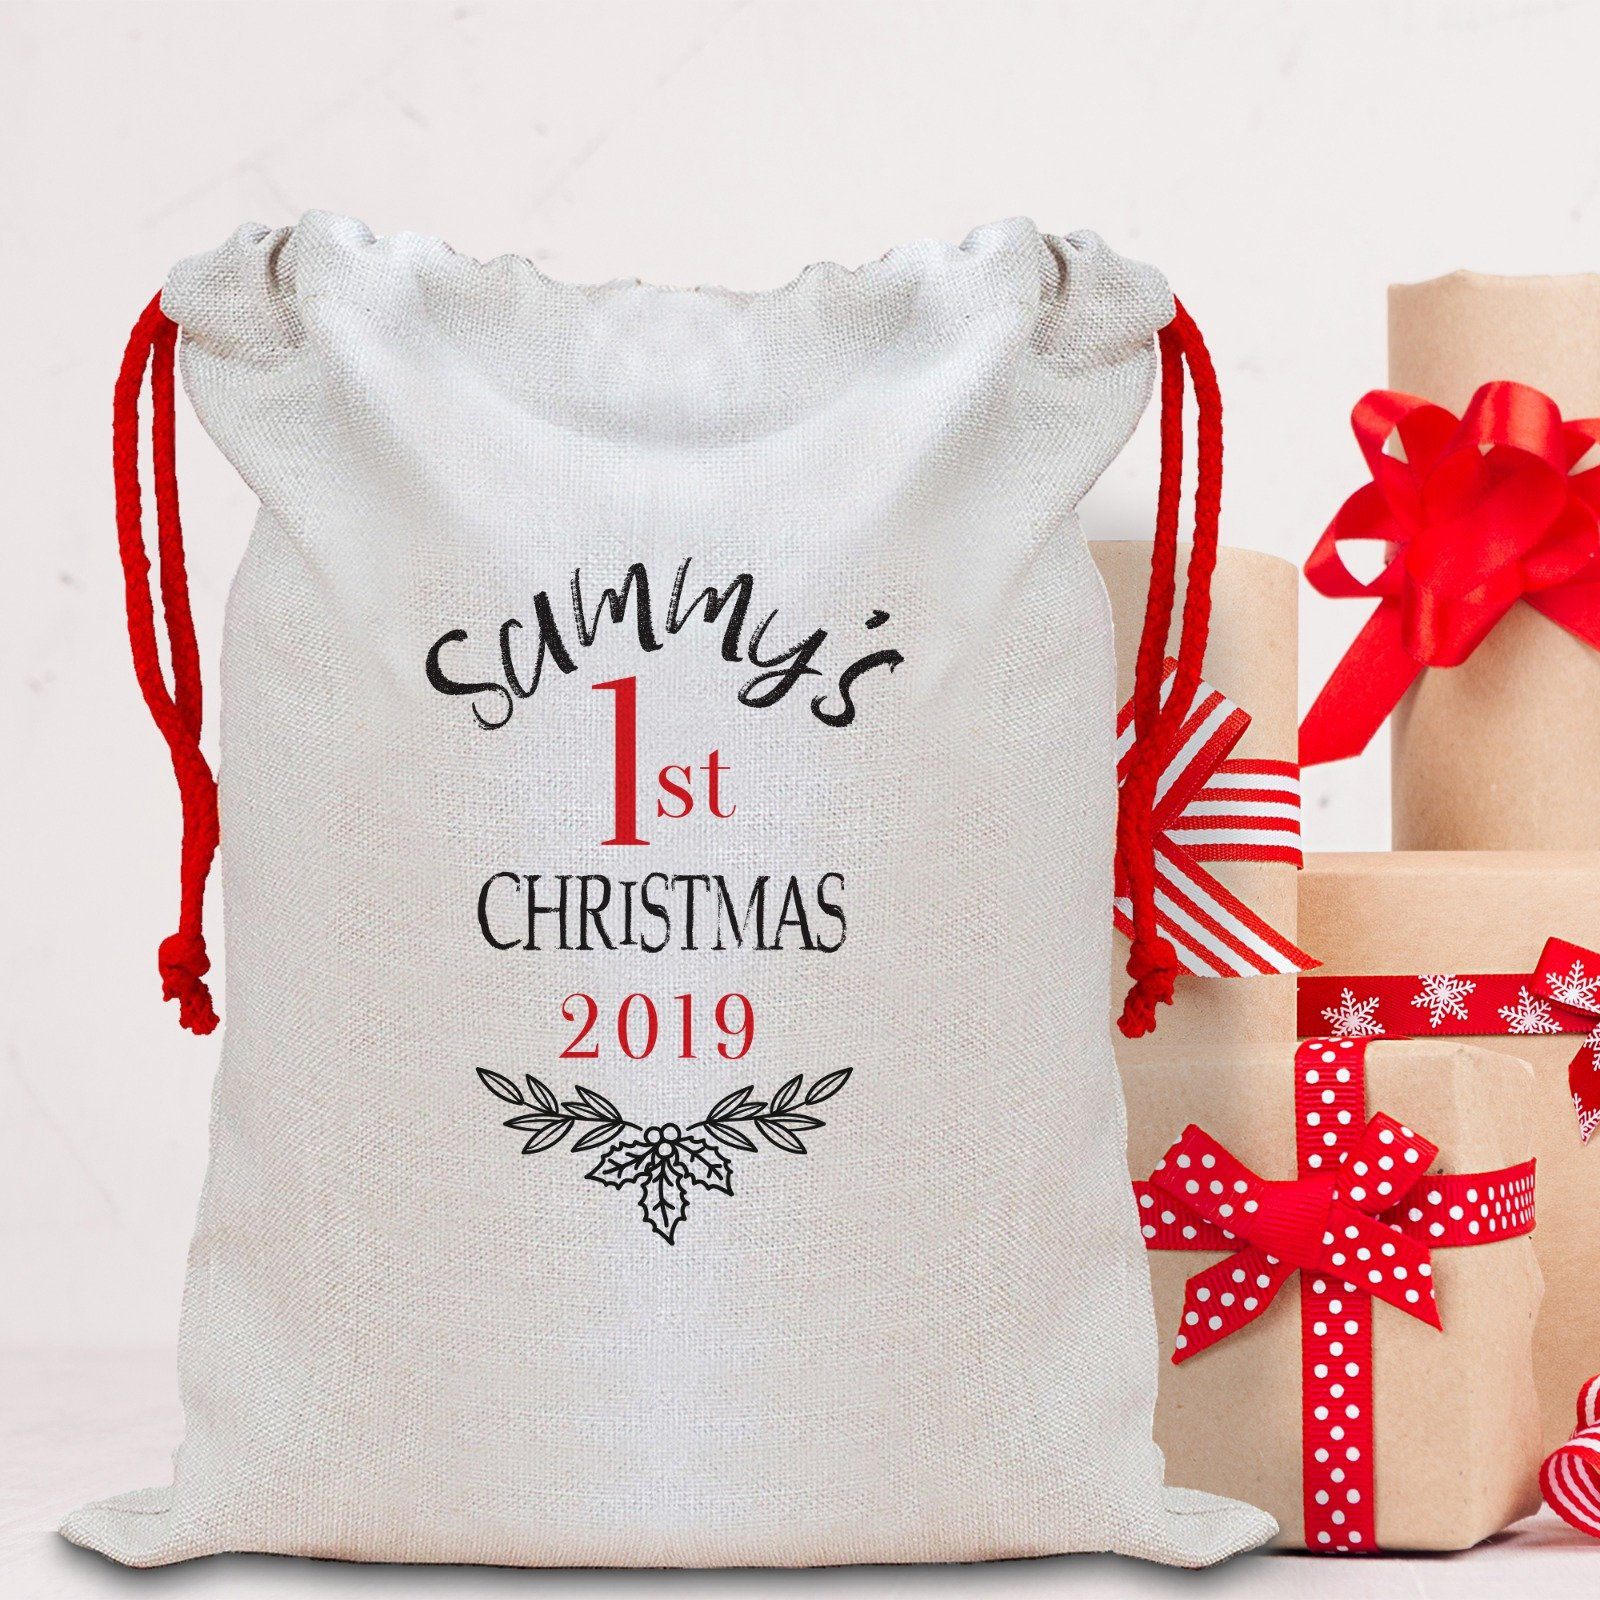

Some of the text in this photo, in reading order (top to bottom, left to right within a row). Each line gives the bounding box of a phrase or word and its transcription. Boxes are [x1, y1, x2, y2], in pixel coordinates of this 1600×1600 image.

[592, 676, 737, 846] 1st
[477, 871, 847, 953] CHRISTMAS
[559, 992, 755, 1059] 2019
